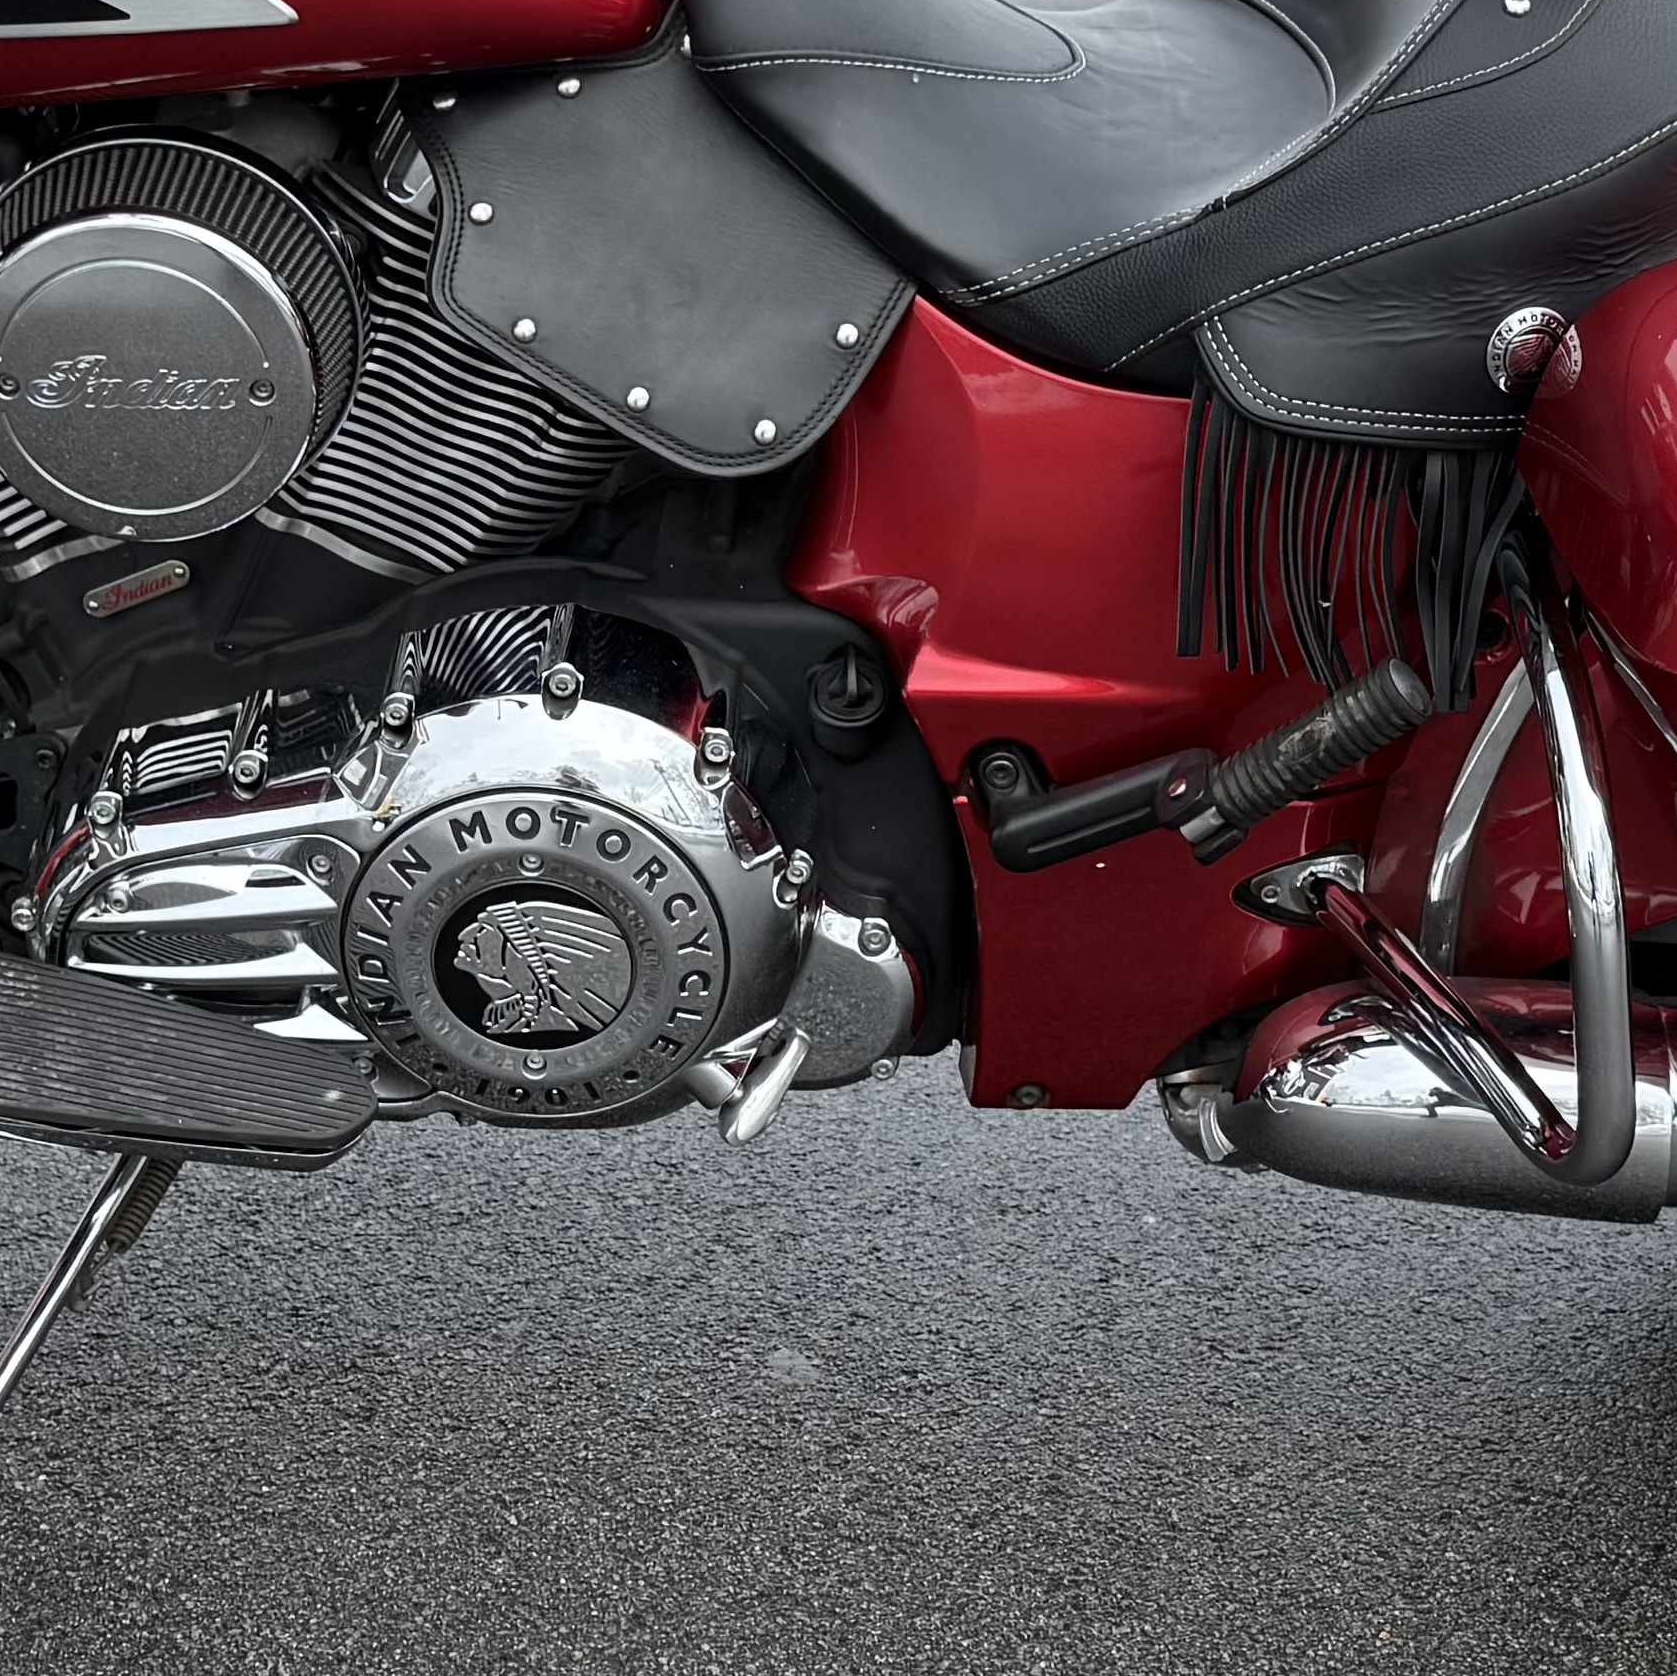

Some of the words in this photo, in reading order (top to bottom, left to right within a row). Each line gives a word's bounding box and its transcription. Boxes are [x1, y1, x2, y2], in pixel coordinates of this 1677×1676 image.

[27, 354, 241, 410] Indian
[101, 573, 173, 611] Indian
[359, 844, 434, 1050] INDIAN
[449, 806, 713, 1062] MOTORCYCLE
[475, 1078, 601, 1108] 1901
